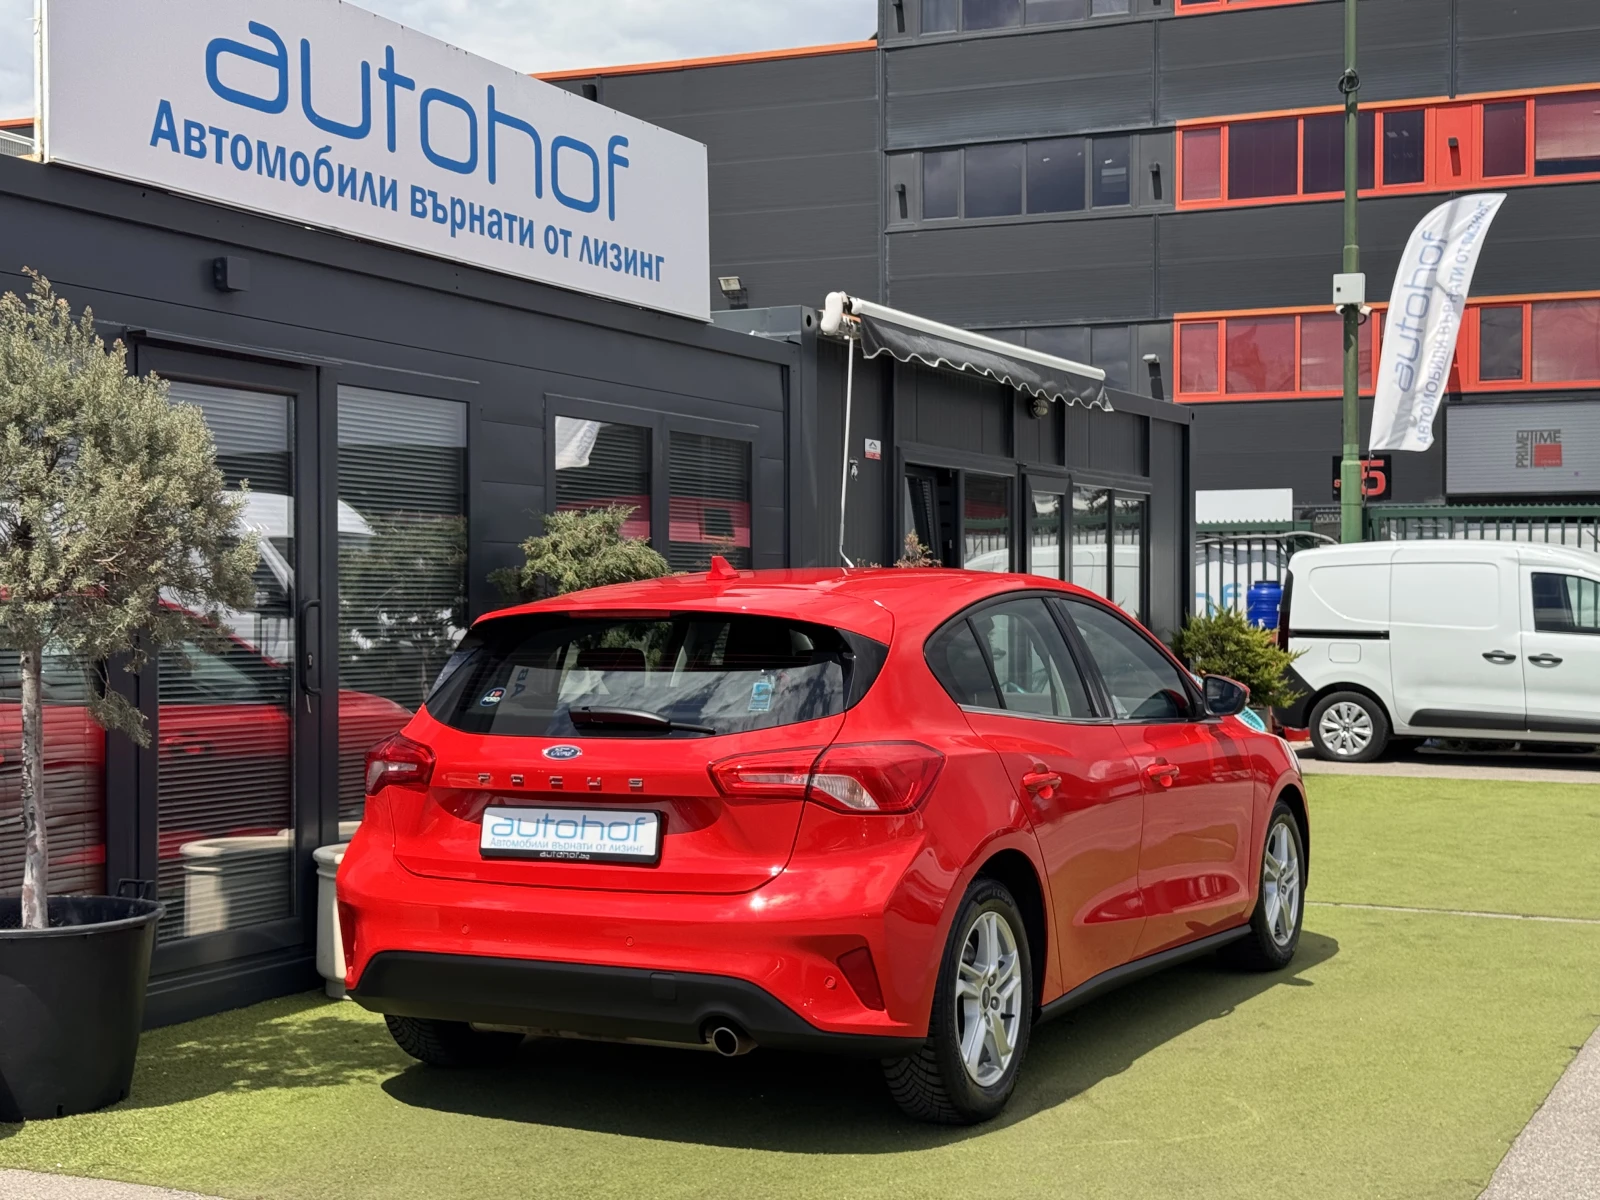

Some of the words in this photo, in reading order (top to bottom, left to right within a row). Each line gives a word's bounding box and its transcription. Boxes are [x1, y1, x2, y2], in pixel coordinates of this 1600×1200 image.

[205, 20, 630, 222] autohof
[149, 98, 399, 212] Автомобили
[410, 184, 535, 249] върнати
[542, 225, 573, 259] от
[578, 235, 666, 283] лизинг
[1394, 230, 1448, 393] autohof
[1515, 430, 1529, 469] PRIME
[477, 772, 644, 788] FOCUS
[491, 813, 647, 842] autohof
[489, 837, 549, 849] Автомобили
[551, 841, 593, 852] върнати
[596, 843, 607, 852] от
[608, 844, 644, 854] лизинг
[540, 850, 591, 860] autohof.bg
